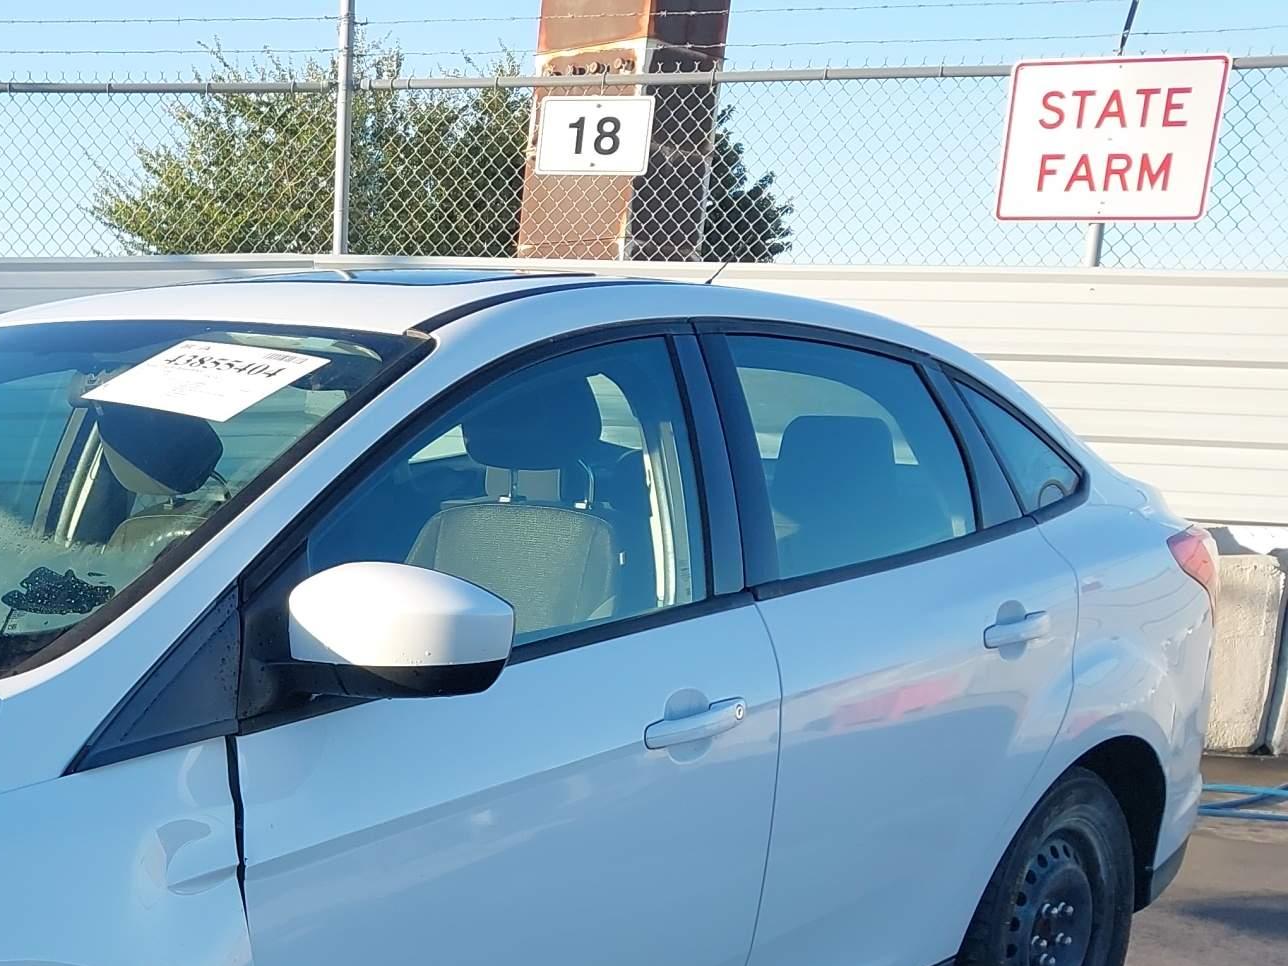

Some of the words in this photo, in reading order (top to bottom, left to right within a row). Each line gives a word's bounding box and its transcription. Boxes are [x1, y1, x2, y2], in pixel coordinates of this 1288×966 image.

[1038, 87, 1192, 129] STATE
[568, 116, 621, 155] 18
[1036, 152, 1173, 192] FARM
[164, 353, 287, 379] 43855404
